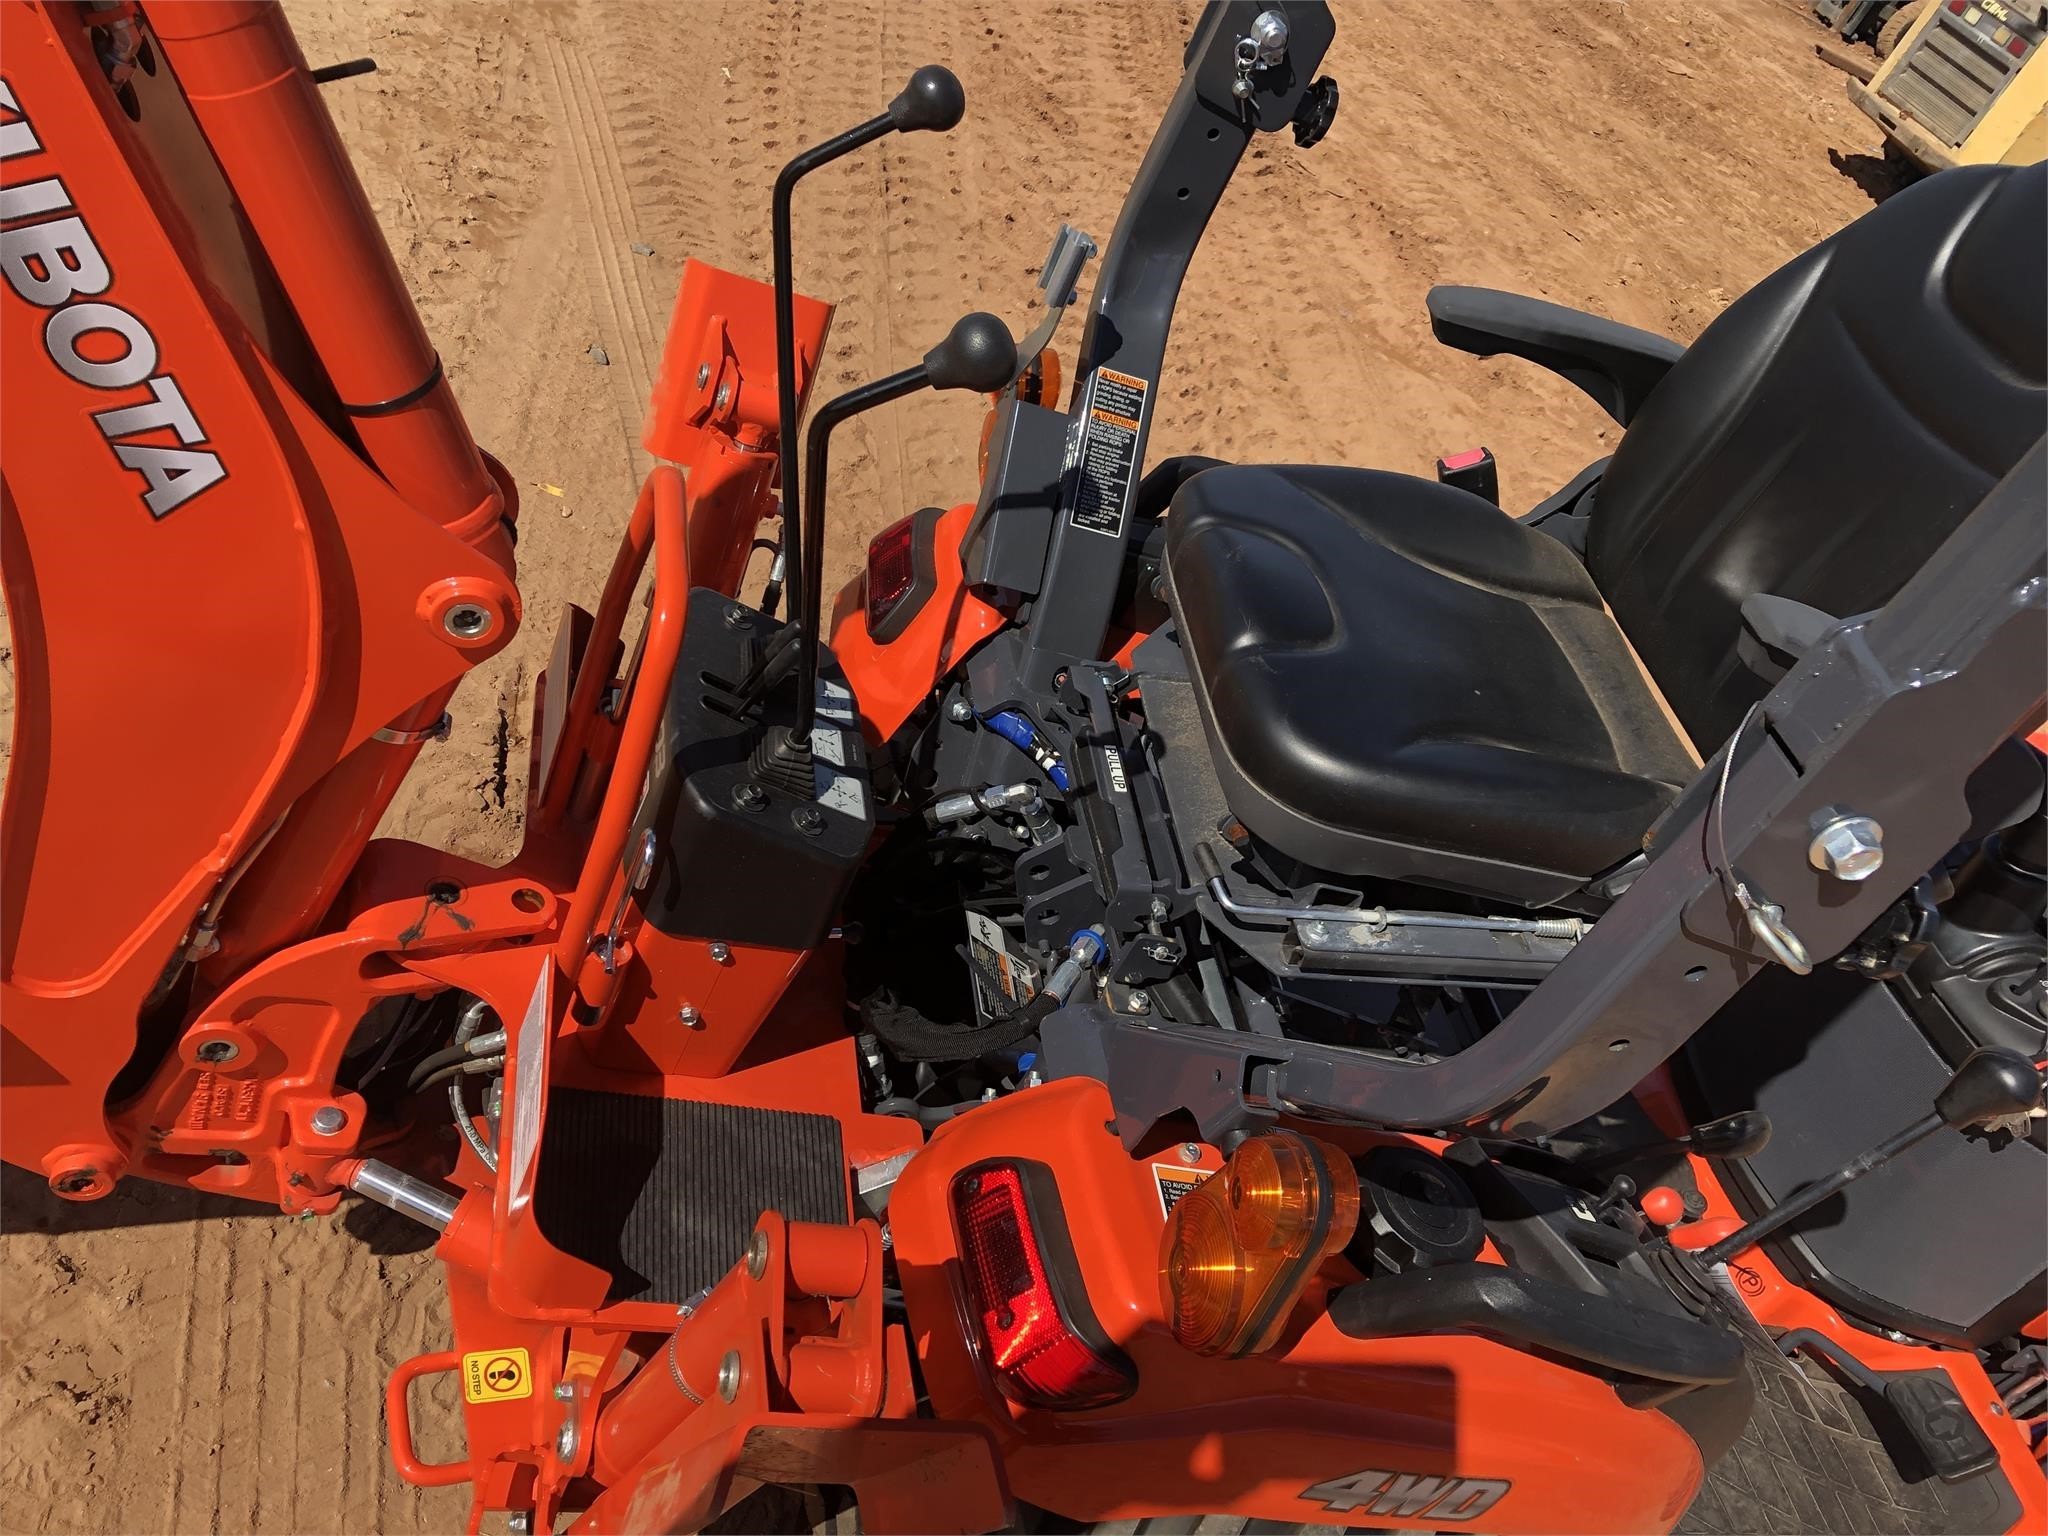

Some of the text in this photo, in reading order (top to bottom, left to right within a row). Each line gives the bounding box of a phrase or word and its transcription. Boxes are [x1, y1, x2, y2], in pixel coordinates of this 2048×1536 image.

[0, 76, 229, 521] UBOTA
[1108, 371, 1144, 388] WARNING
[1101, 412, 1137, 429] WARNING
[1089, 433, 1108, 442] FOLDING
[1106, 747, 1126, 789] PULL UP
[1161, 1180, 1172, 1188] TO
[1172, 1182, 1193, 1191] AVOID
[471, 1360, 482, 1396] NO STEP
[1297, 1468, 1513, 1522] 4WD
